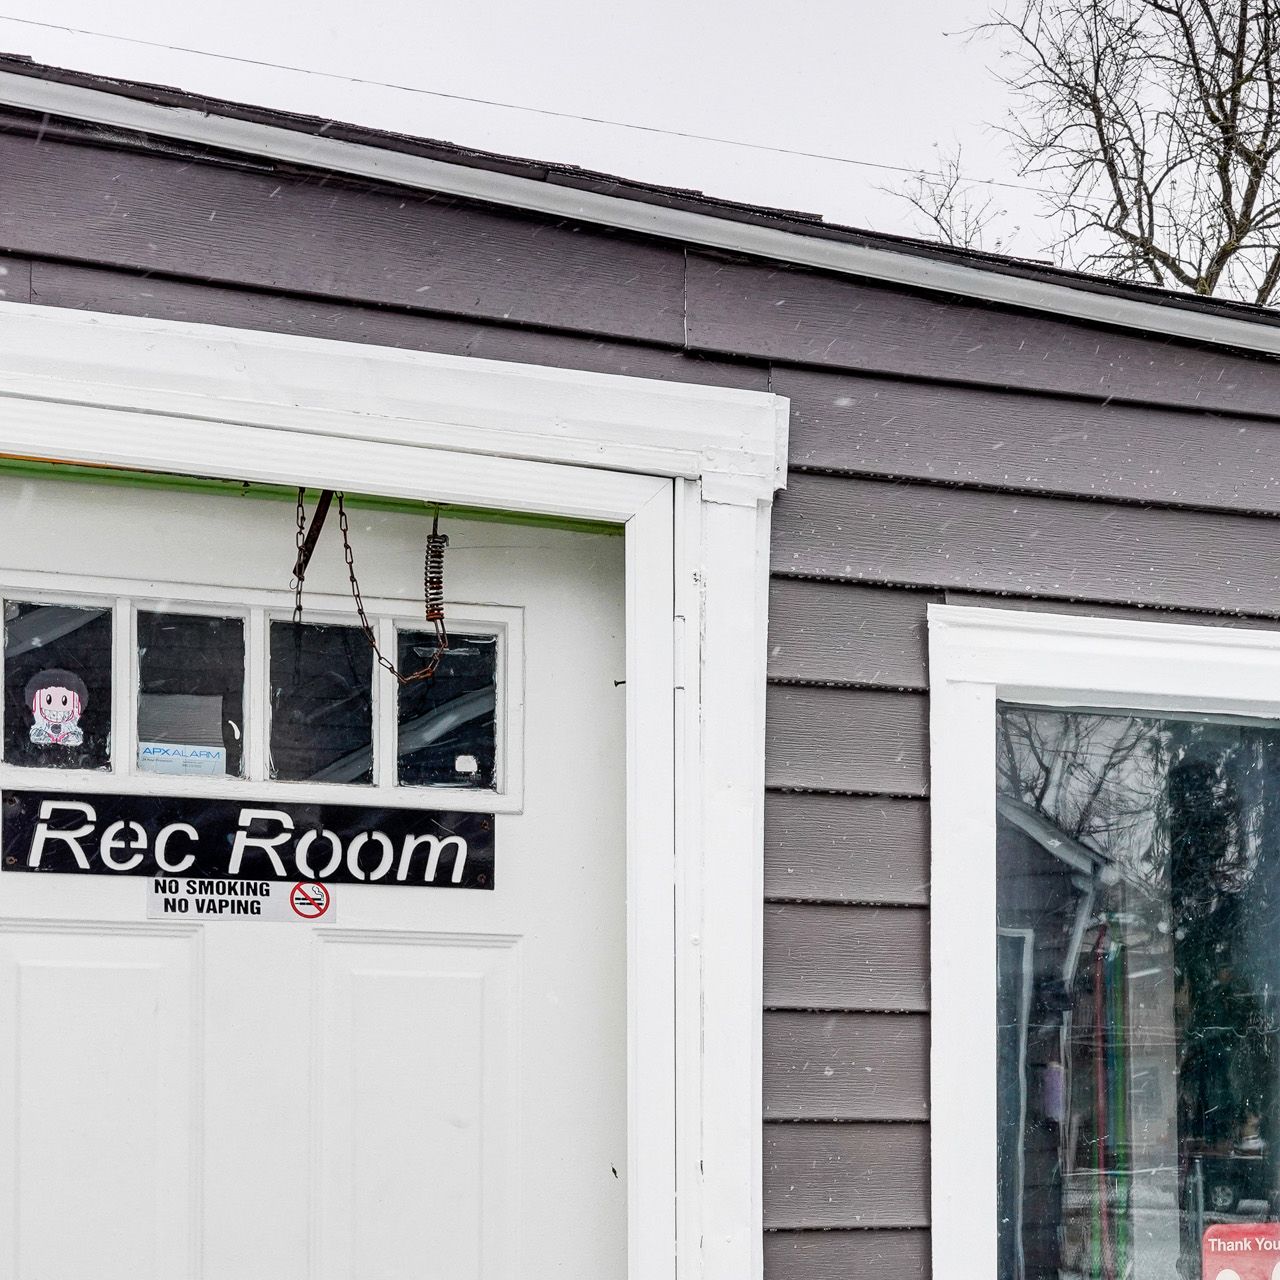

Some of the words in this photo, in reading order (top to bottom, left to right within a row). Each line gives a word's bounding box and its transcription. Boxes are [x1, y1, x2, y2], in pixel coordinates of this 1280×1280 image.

[28, 800, 200, 873] Rec
[227, 807, 469, 884] Room
[154, 878, 179, 895] NO
[186, 879, 271, 897] SMOKING
[163, 897, 189, 914] NO
[194, 898, 262, 916] VAPING
[1208, 1237, 1252, 1252] Thank
[1255, 1237, 1280, 1251] You
